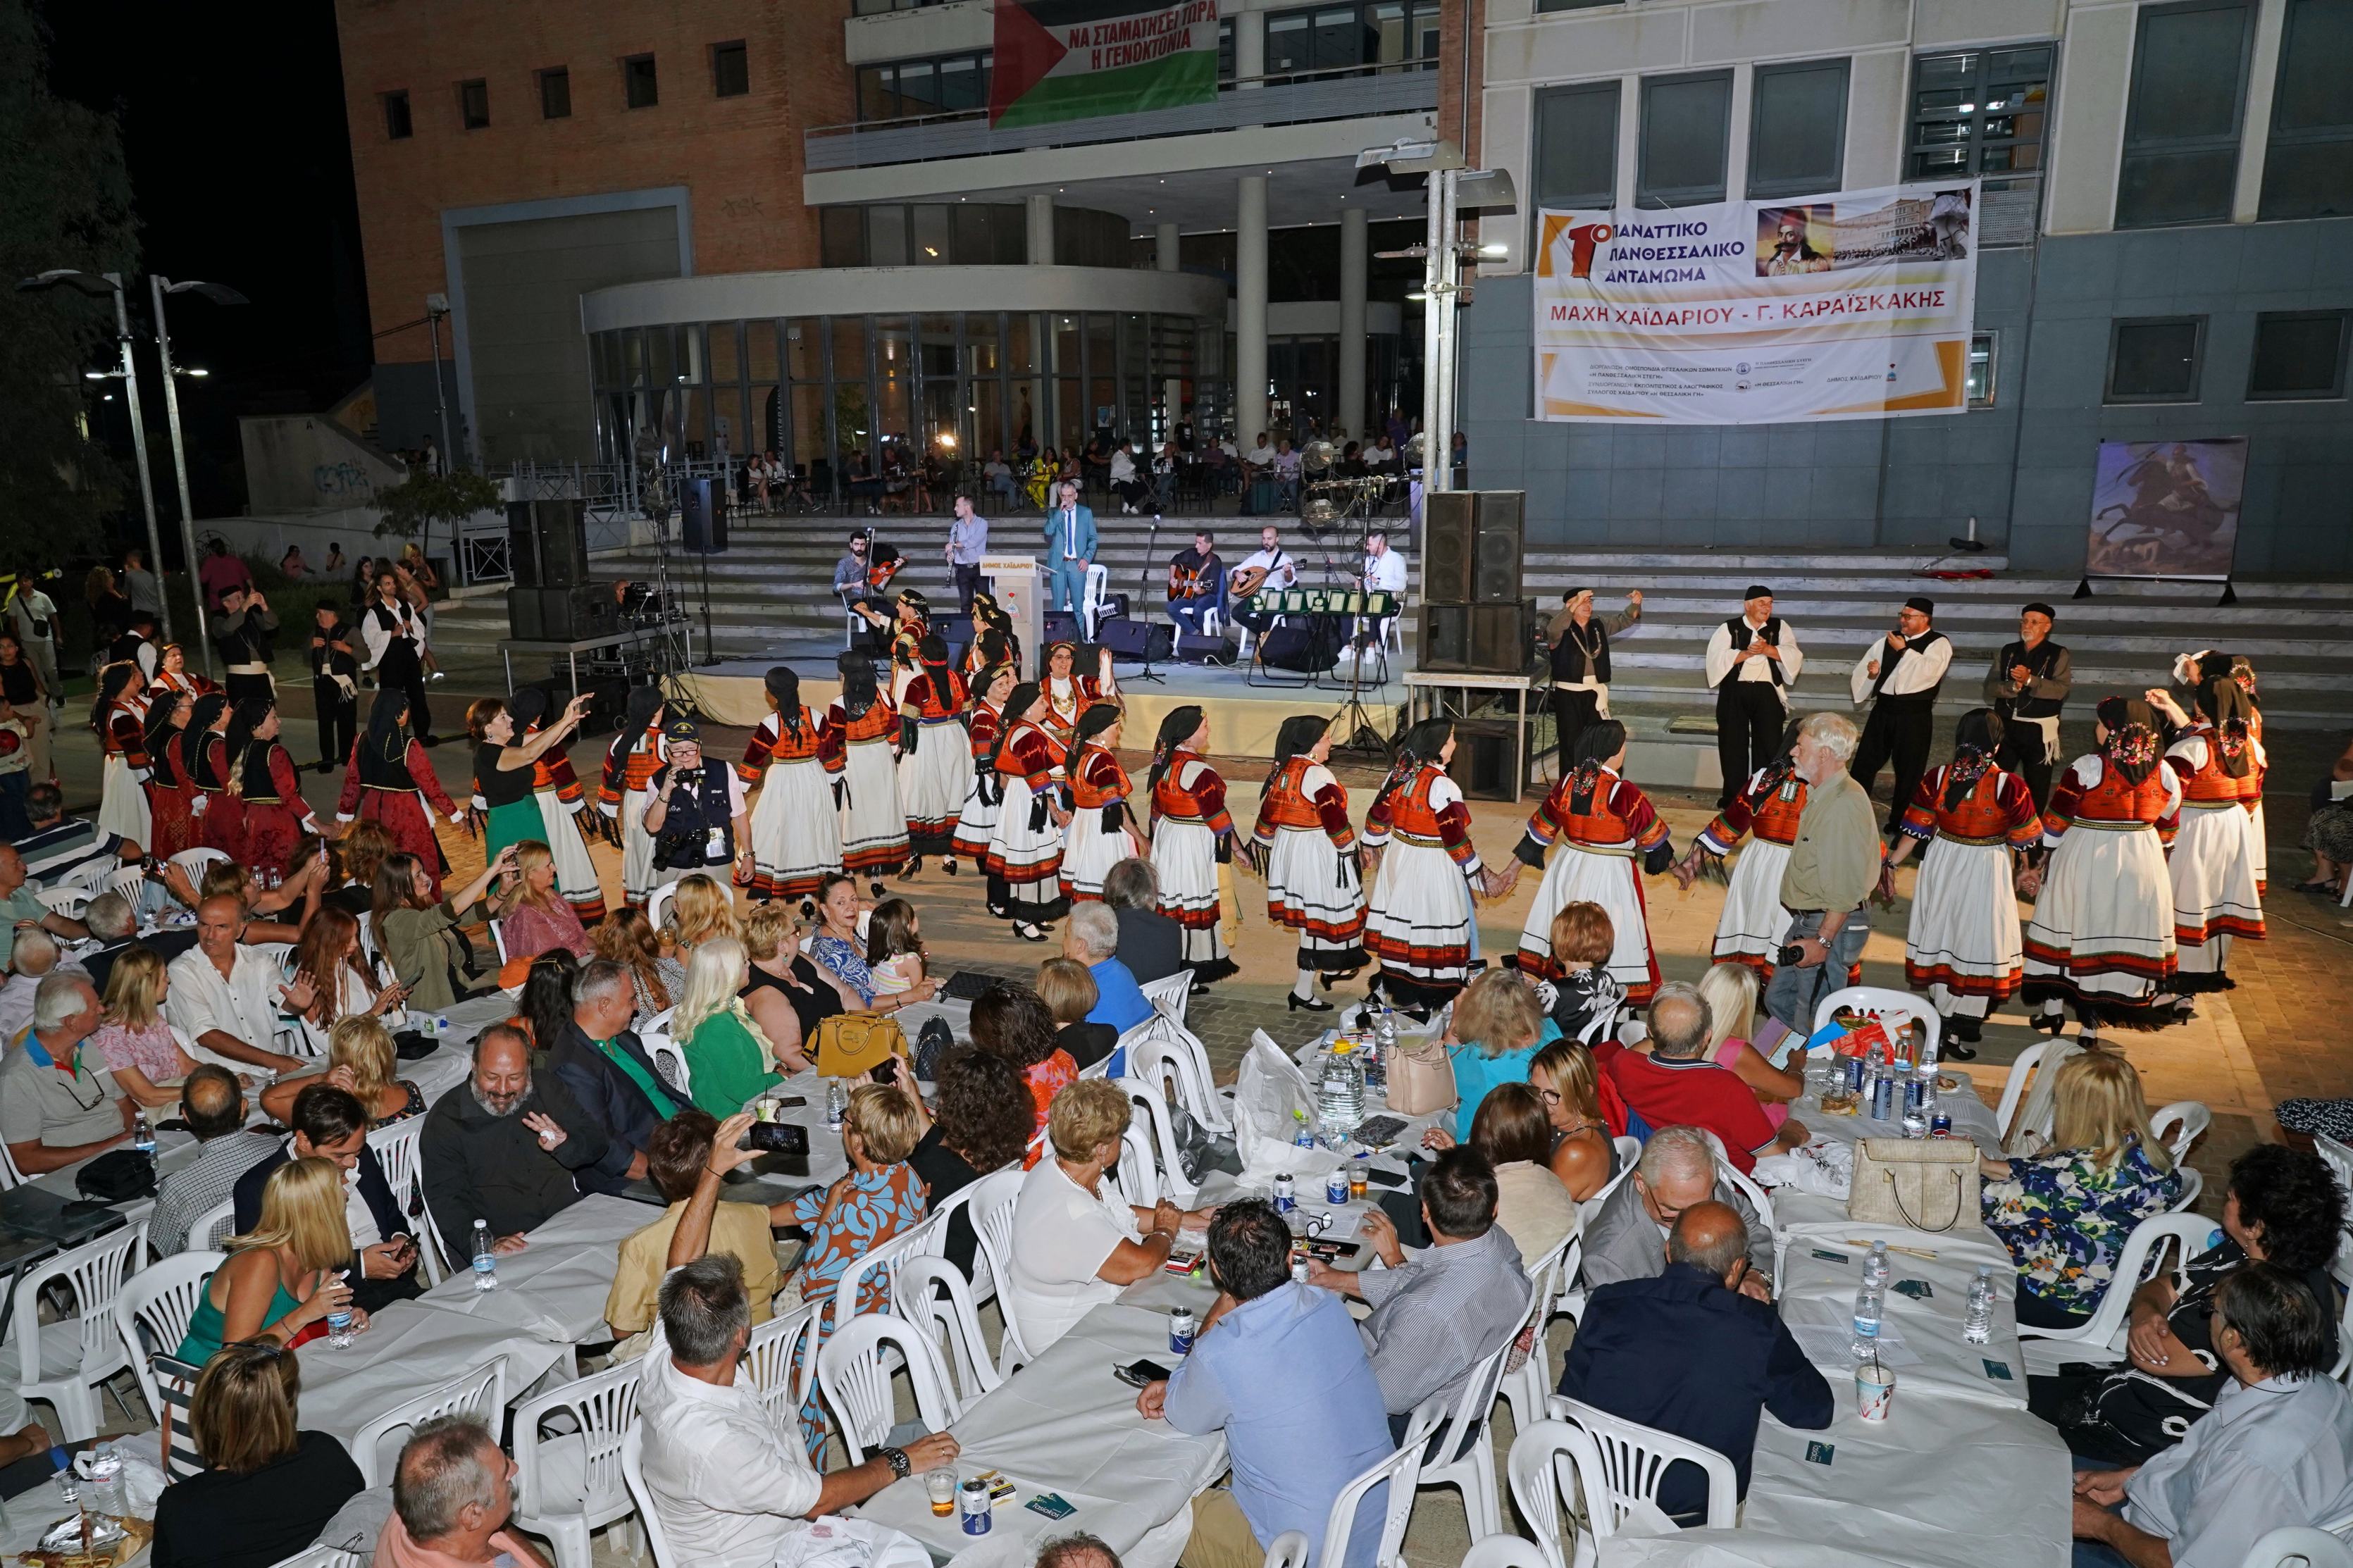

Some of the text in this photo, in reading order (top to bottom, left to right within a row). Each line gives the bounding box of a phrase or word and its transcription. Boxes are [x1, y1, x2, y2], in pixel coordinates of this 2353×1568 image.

[1069, 0, 1217, 49] ΝΑ ΣΤΑΜΑΤΗΣΕΙ ΤΩΡΑ
[1091, 27, 1191, 70] Η ΓΕΝΟΚΤΟΝΙΑ
[1613, 221, 1708, 239] ΠΑΝΑΤΤΙΚΟ
[1609, 241, 1745, 261] ΠΑΝΘΕΣΣΑΛΙΚΟ
[1604, 266, 1706, 284] ΑΝΤΑΜΩΜΑ
[1551, 306, 1609, 322] ΜΑΧΗ
[1615, 307, 1734, 325] ΧΑΪΔΑΡΙΟΥ
[1758, 305, 1773, 321] Γ.
[1783, 290, 1945, 319] ΚΑΡΑΪΣΚΑΚΗΣ
[1032, 1502, 1060, 1518] Tasiakos
